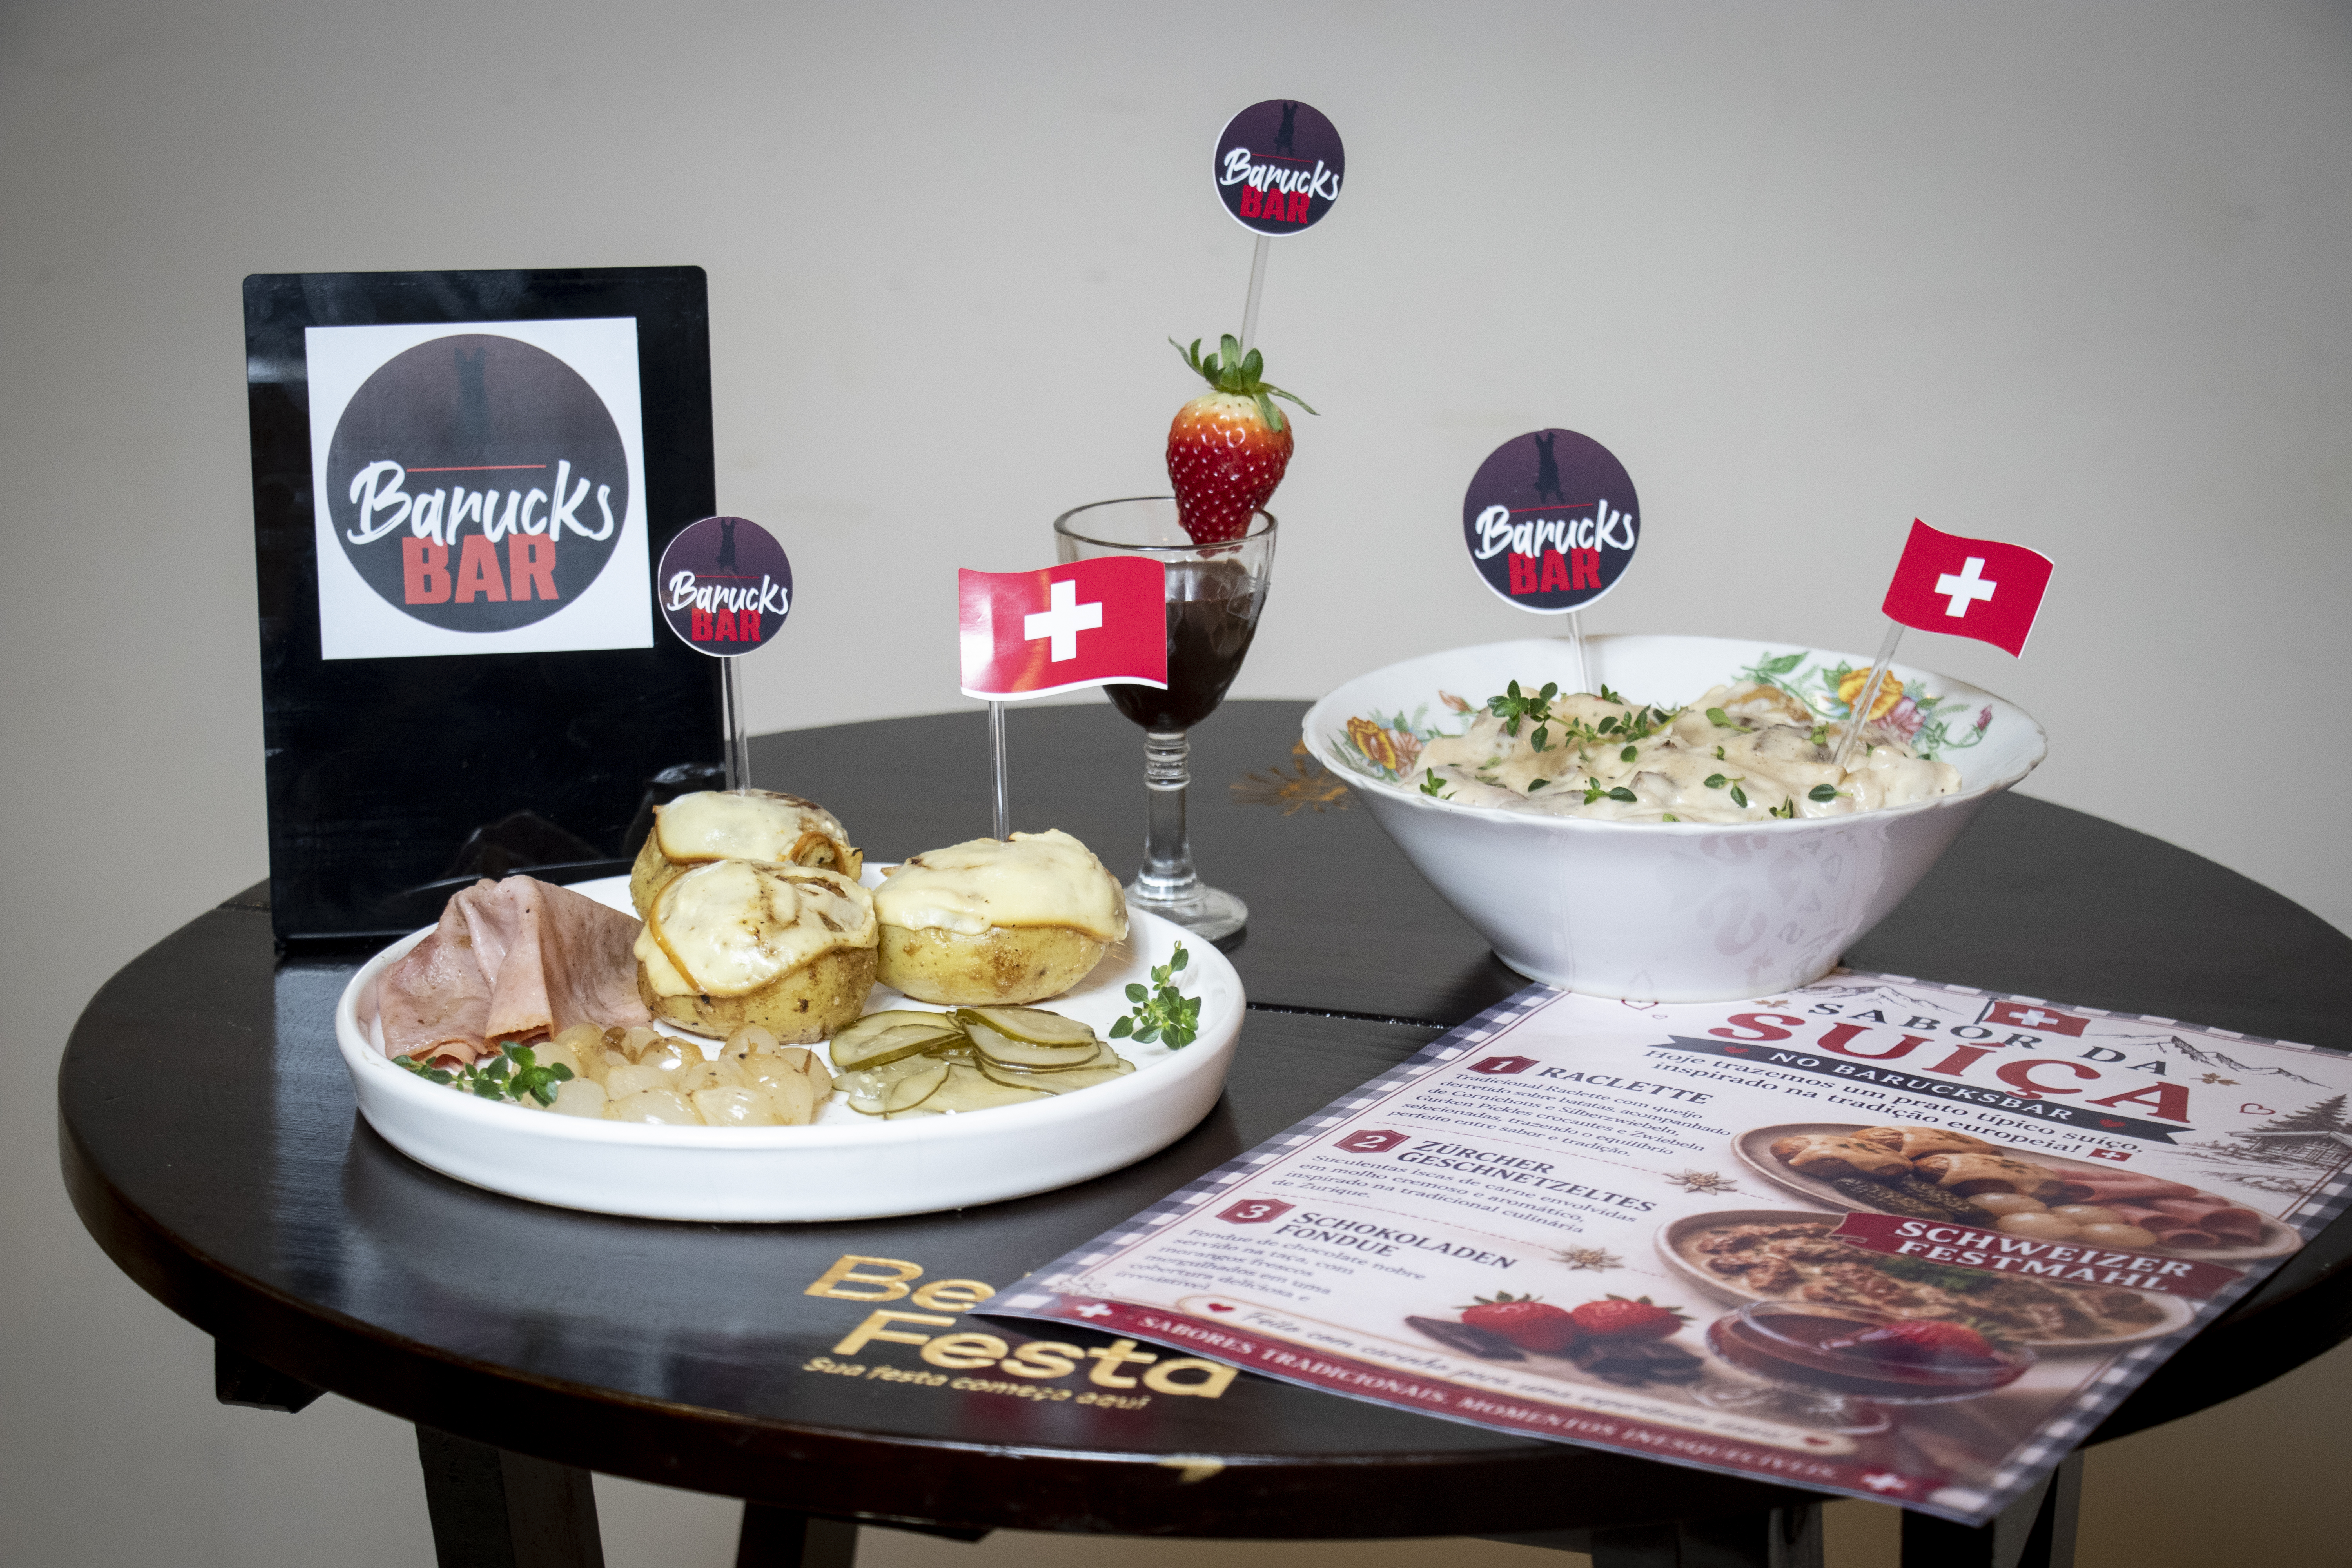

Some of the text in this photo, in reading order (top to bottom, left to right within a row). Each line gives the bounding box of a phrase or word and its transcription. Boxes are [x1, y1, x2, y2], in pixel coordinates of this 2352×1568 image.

[1219, 148, 1339, 200] Barucks
[1240, 185, 1310, 224] BAR
[347, 459, 615, 546] Barucks
[1474, 499, 1635, 559] Barucks
[401, 533, 559, 605] BAR
[667, 571, 788, 615] Barucks
[1508, 547, 1602, 595] BAR
[691, 608, 761, 642] BAR
[1489, 1061, 1514, 1071] 1
[1808, 1004, 2167, 1076] SABOR DA
[1535, 1067, 1714, 1104] RACLETTE
[1708, 1013, 2191, 1123] SUÍÇA
[1768, 1052, 2073, 1120] NO BARUCKSBAR
[1440, 1081, 1731, 1136] derretido sobre batatas, acompanhado
[1452, 1091, 1542, 1109] Cornichons
[1558, 1106, 1679, 1136] Silberzwiebeln,
[1454, 1074, 1702, 1119] Tradicional Raclette com queijo
[1642, 1050, 2143, 1153] Hoje trazemos um prato típico suíço,
[1651, 1062, 2083, 1152] inspirado na tradição europeia!
[1352, 1136, 1387, 1149] 2
[1387, 1111, 1451, 1123] perfeito
[1454, 1119, 1497, 1130] entre
[1499, 1125, 1545, 1139] sabor
[1561, 1138, 1630, 1156] tradição.
[1402, 1103, 1502, 1122] selecionadas,
[1508, 1118, 1578, 1134] trazendo
[1596, 1135, 1674, 1155] equilíbrio
[1416, 1096, 1474, 1107] Gurken
[1477, 1103, 1532, 1116] Pickles
[1536, 1113, 1614, 1131] crocantes
[1630, 1131, 1704, 1151] Zwiebeln
[1397, 1152, 1657, 1212] GESCHNETZELTES
[1411, 1141, 1555, 1174] ZÜRCHER
[1236, 1205, 1271, 1218] 3
[1284, 1171, 1368, 1188] inspirado
[1400, 1187, 1500, 1213] tradicional
[1502, 1210, 1584, 1233] culinária
[1298, 1182, 1371, 1198] Zurique.
[1312, 1155, 1407, 1173] Suculentas
[1411, 1169, 1455, 1181] iscas
[1485, 1184, 1536, 1198] carne
[1541, 1196, 1637, 1222] envolvidas
[1332, 1168, 1388, 1179] molho
[1392, 1177, 1468, 1194] cremoso
[1488, 1196, 1584, 1222] aromático,
[1158, 1247, 1314, 1278] morangos frescos
[1173, 1239, 1238, 1251] servido
[1315, 1260, 1355, 1275] com
[1188, 1230, 1252, 1243] Fondue
[1282, 1242, 1369, 1265] chocolate
[1371, 1262, 1426, 1281] nobre
[1273, 1224, 1399, 1257] FONDUE
[1292, 1212, 1518, 1270] SCHOKOLADEN
[1894, 1221, 2194, 1279] SCHWEIZER
[1895, 1240, 2168, 1291] FESTMAHL
[804, 1254, 996, 1311] Be
[1259, 1273, 1287, 1283] em
[1291, 1280, 1331, 1295] uma
[802, 1357, 866, 1376] Sua
[865, 1365, 949, 1387] festa
[832, 1309, 1240, 1398] Festa
[1138, 1316, 1256, 1355] SABORES
[1456, 1397, 1617, 1436] MOMENTOS
